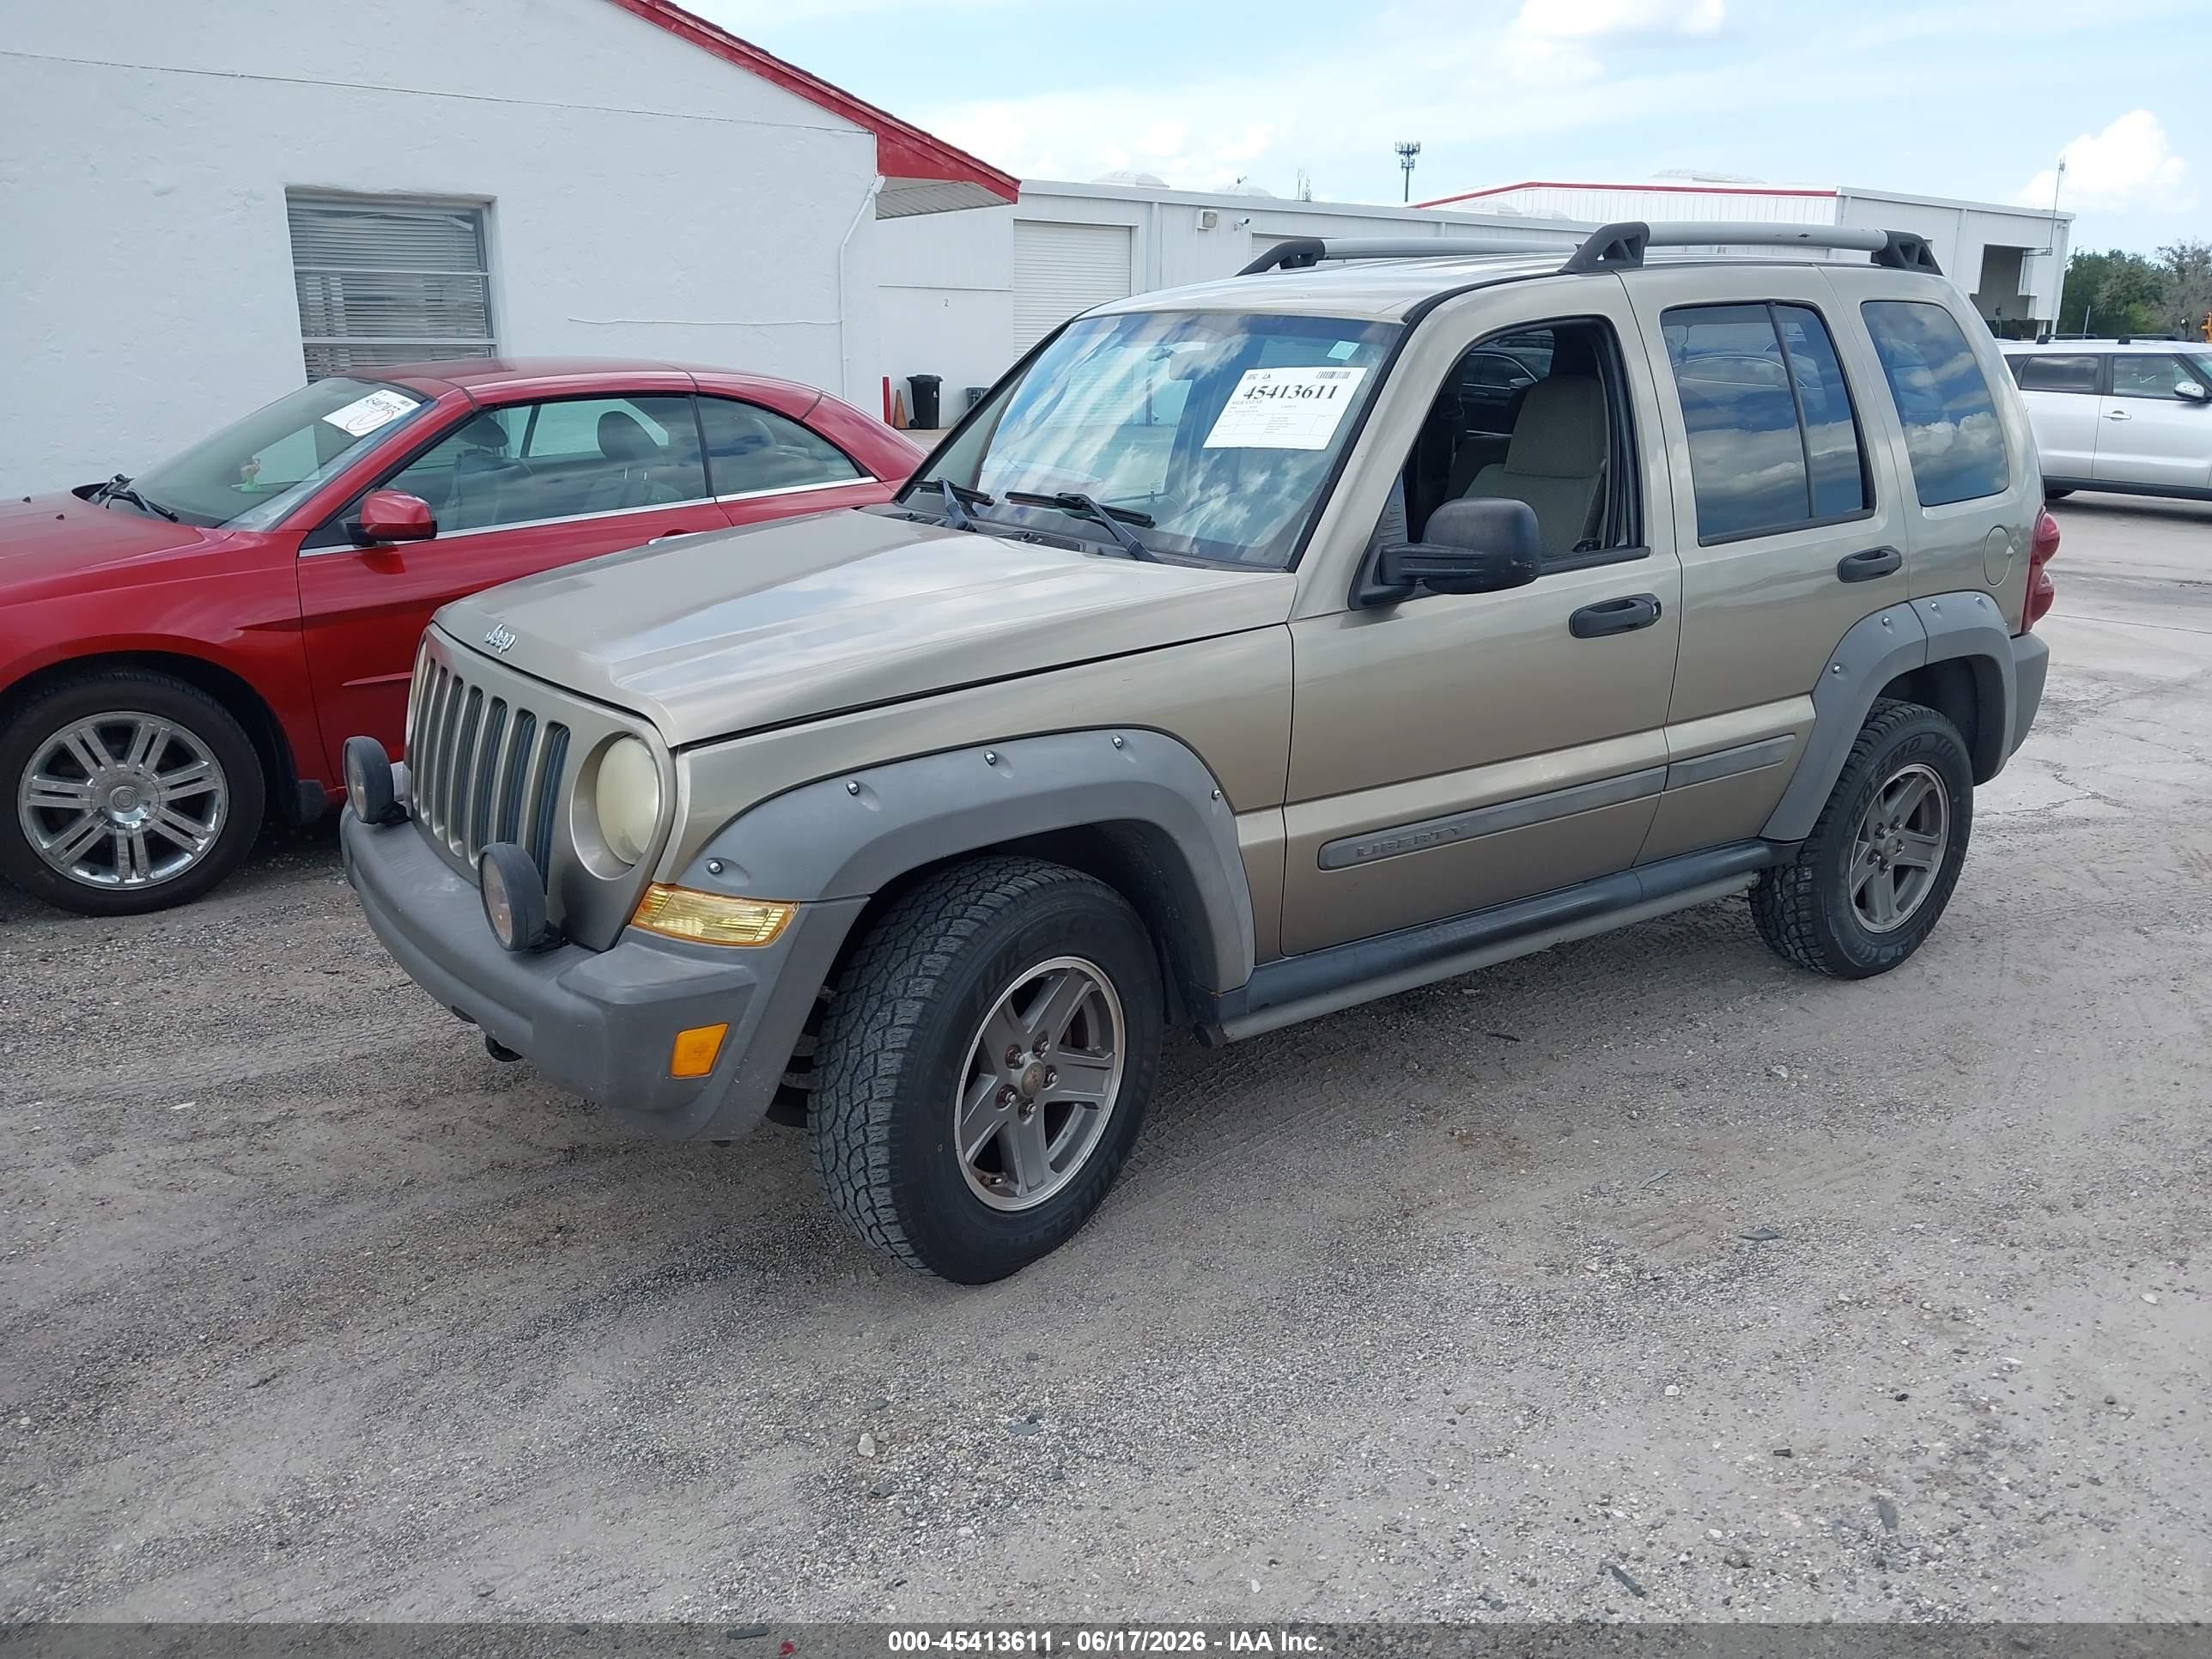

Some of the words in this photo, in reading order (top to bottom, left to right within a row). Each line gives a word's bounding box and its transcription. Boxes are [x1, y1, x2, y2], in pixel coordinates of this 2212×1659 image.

[1243, 384, 1339, 400] 45413611
[485, 624, 516, 653] Jeep
[1356, 823, 1469, 858] LIBERTY
